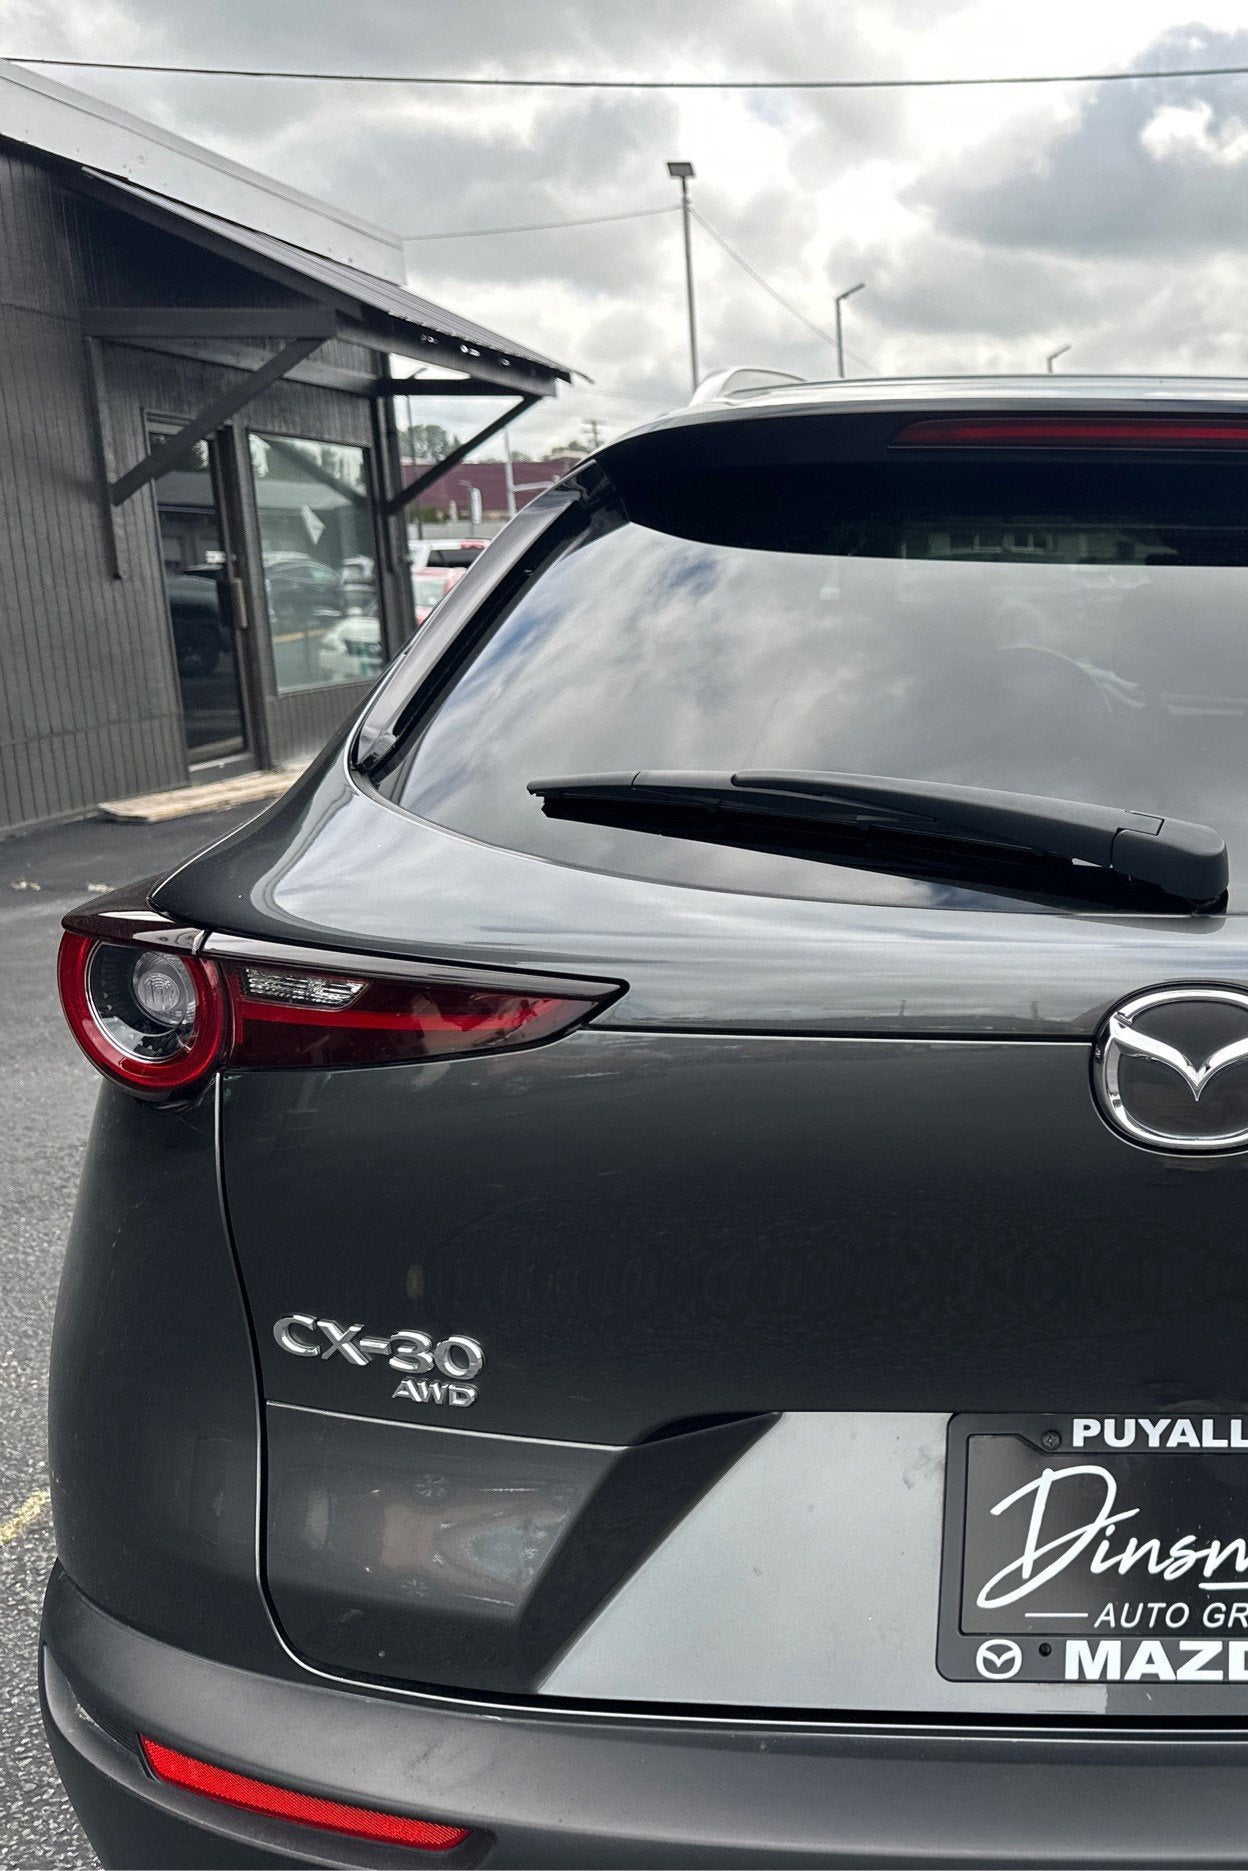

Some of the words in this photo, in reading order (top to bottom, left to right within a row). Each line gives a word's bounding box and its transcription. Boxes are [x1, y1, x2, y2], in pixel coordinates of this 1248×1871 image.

[272, 1313, 487, 1380] CX-30
[391, 1376, 479, 1408] AWD
[1094, 1602, 1190, 1629] AUTO
